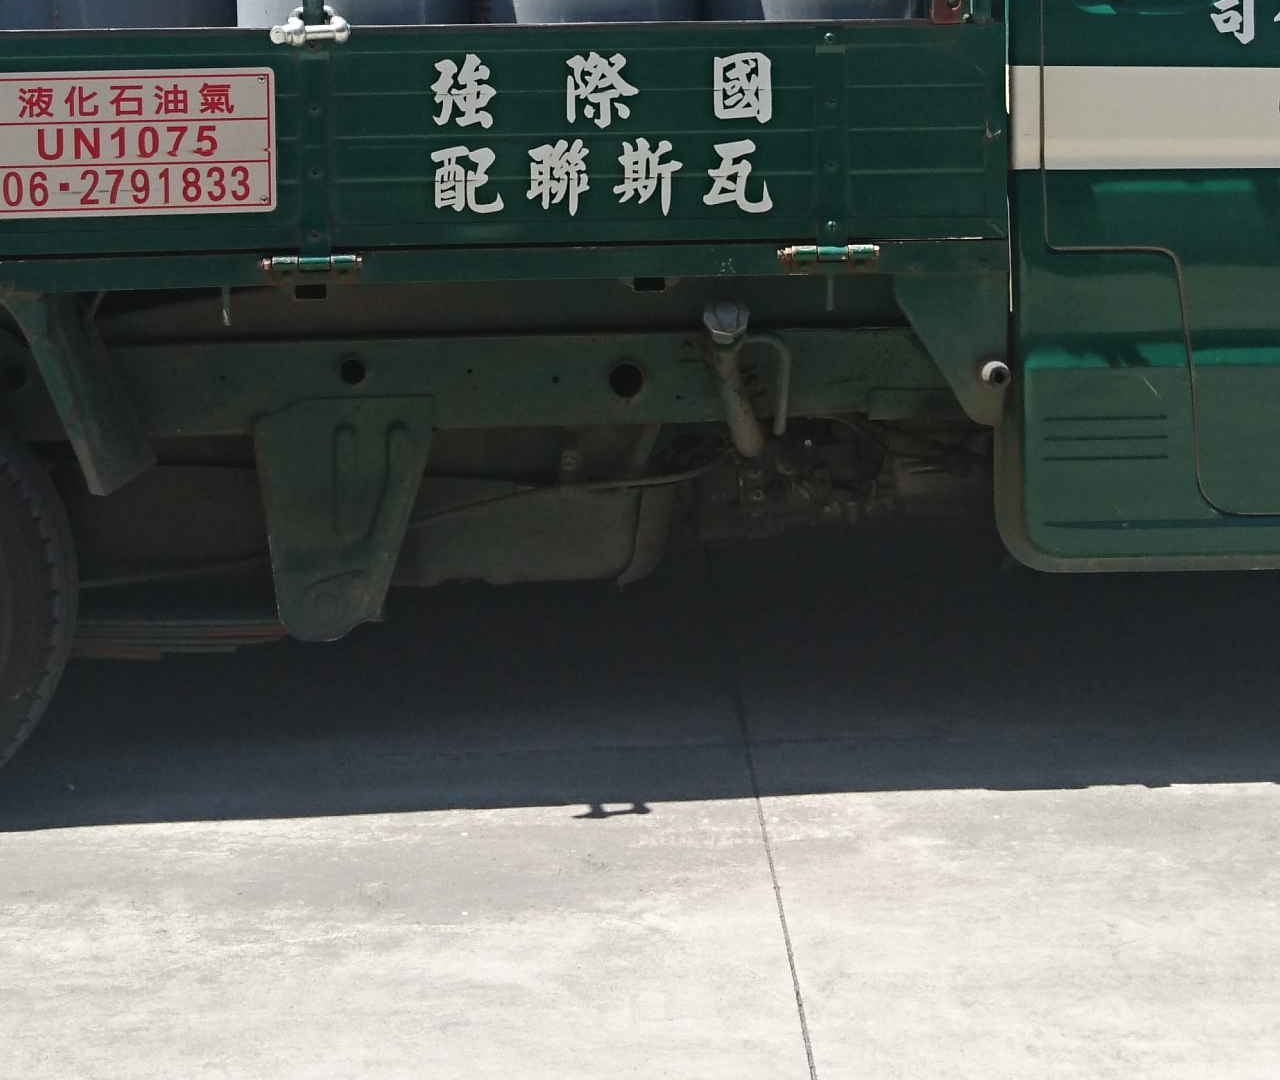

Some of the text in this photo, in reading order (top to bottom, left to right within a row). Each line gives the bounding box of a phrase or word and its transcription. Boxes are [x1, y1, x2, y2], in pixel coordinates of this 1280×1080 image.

[18, 83, 235, 120] 液化石油氣
[36, 124, 220, 162] UN1075
